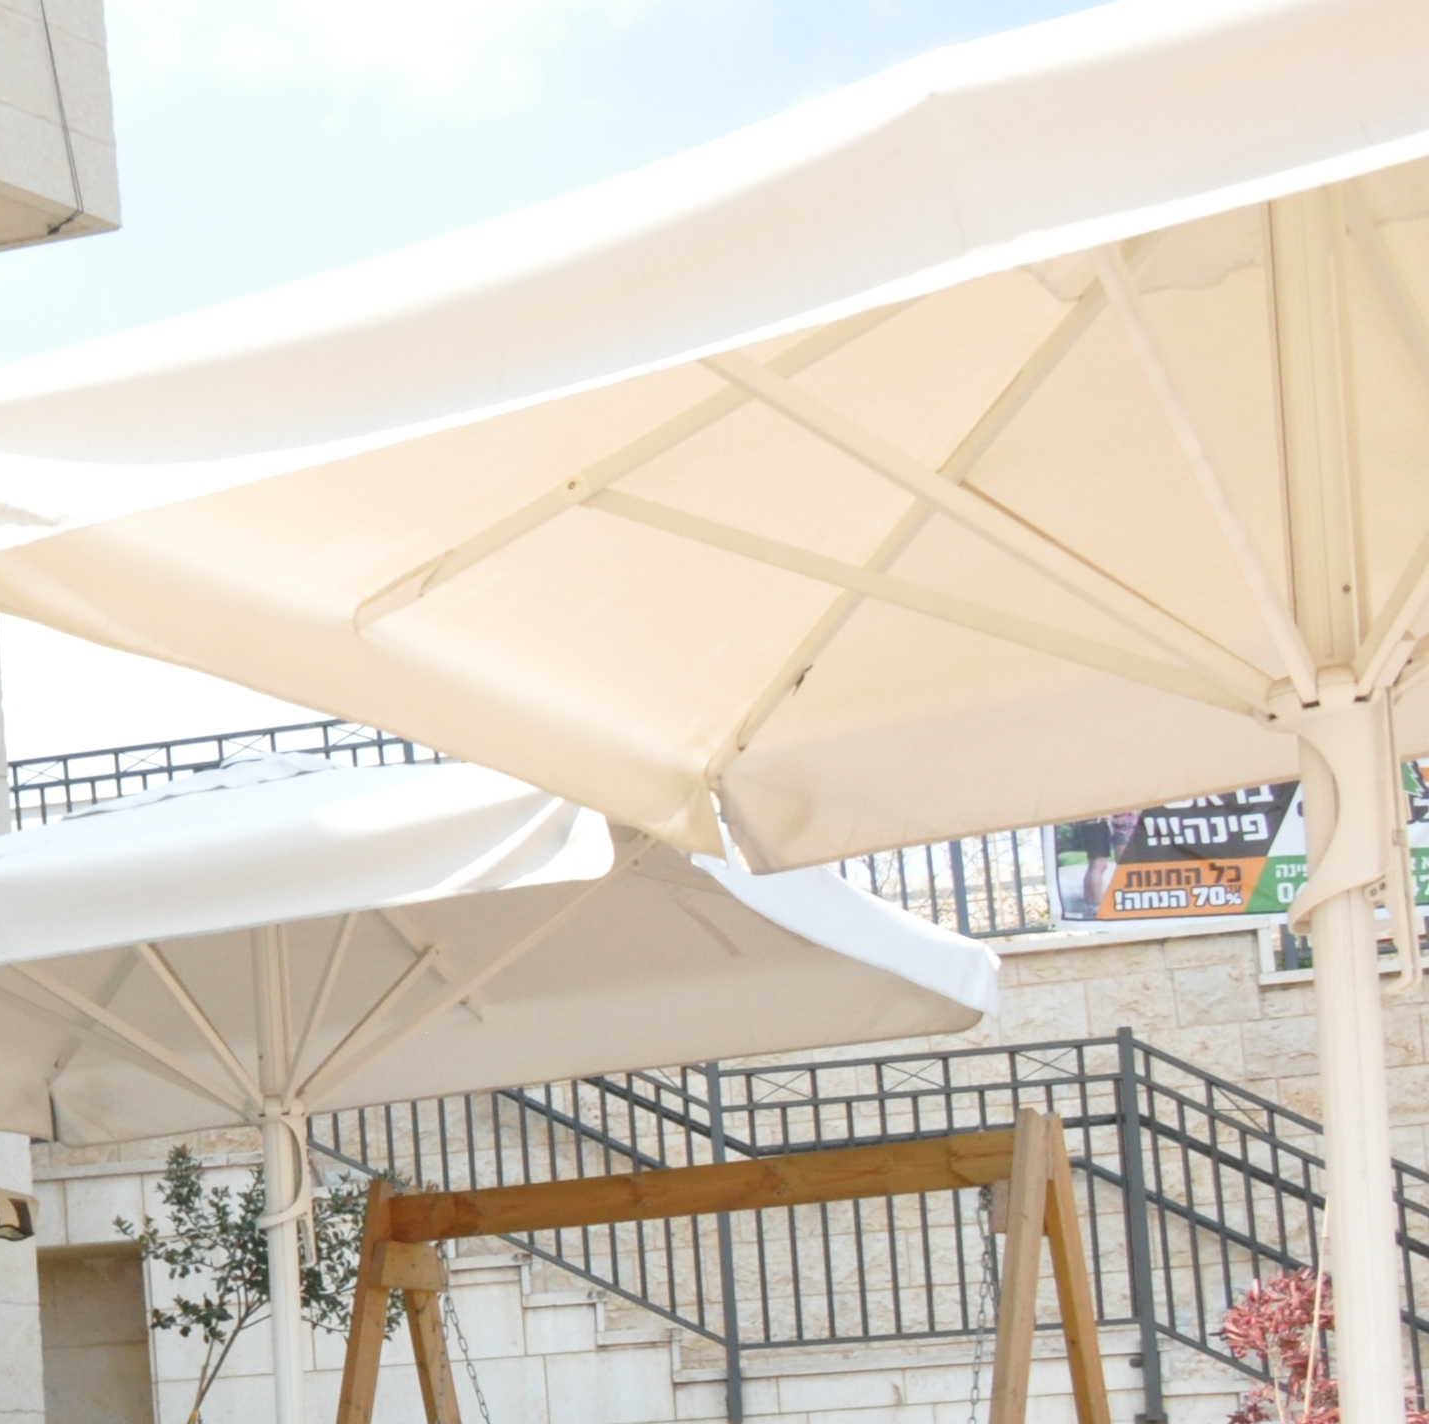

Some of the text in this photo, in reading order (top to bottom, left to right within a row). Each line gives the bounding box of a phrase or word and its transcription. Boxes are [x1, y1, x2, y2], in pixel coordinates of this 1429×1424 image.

[1143, 812, 1270, 847] פינה!!!
[1124, 862, 1243, 890] כל החנות
[1113, 888, 1189, 912] הנחה!
[1191, 884, 1242, 908] 70%
